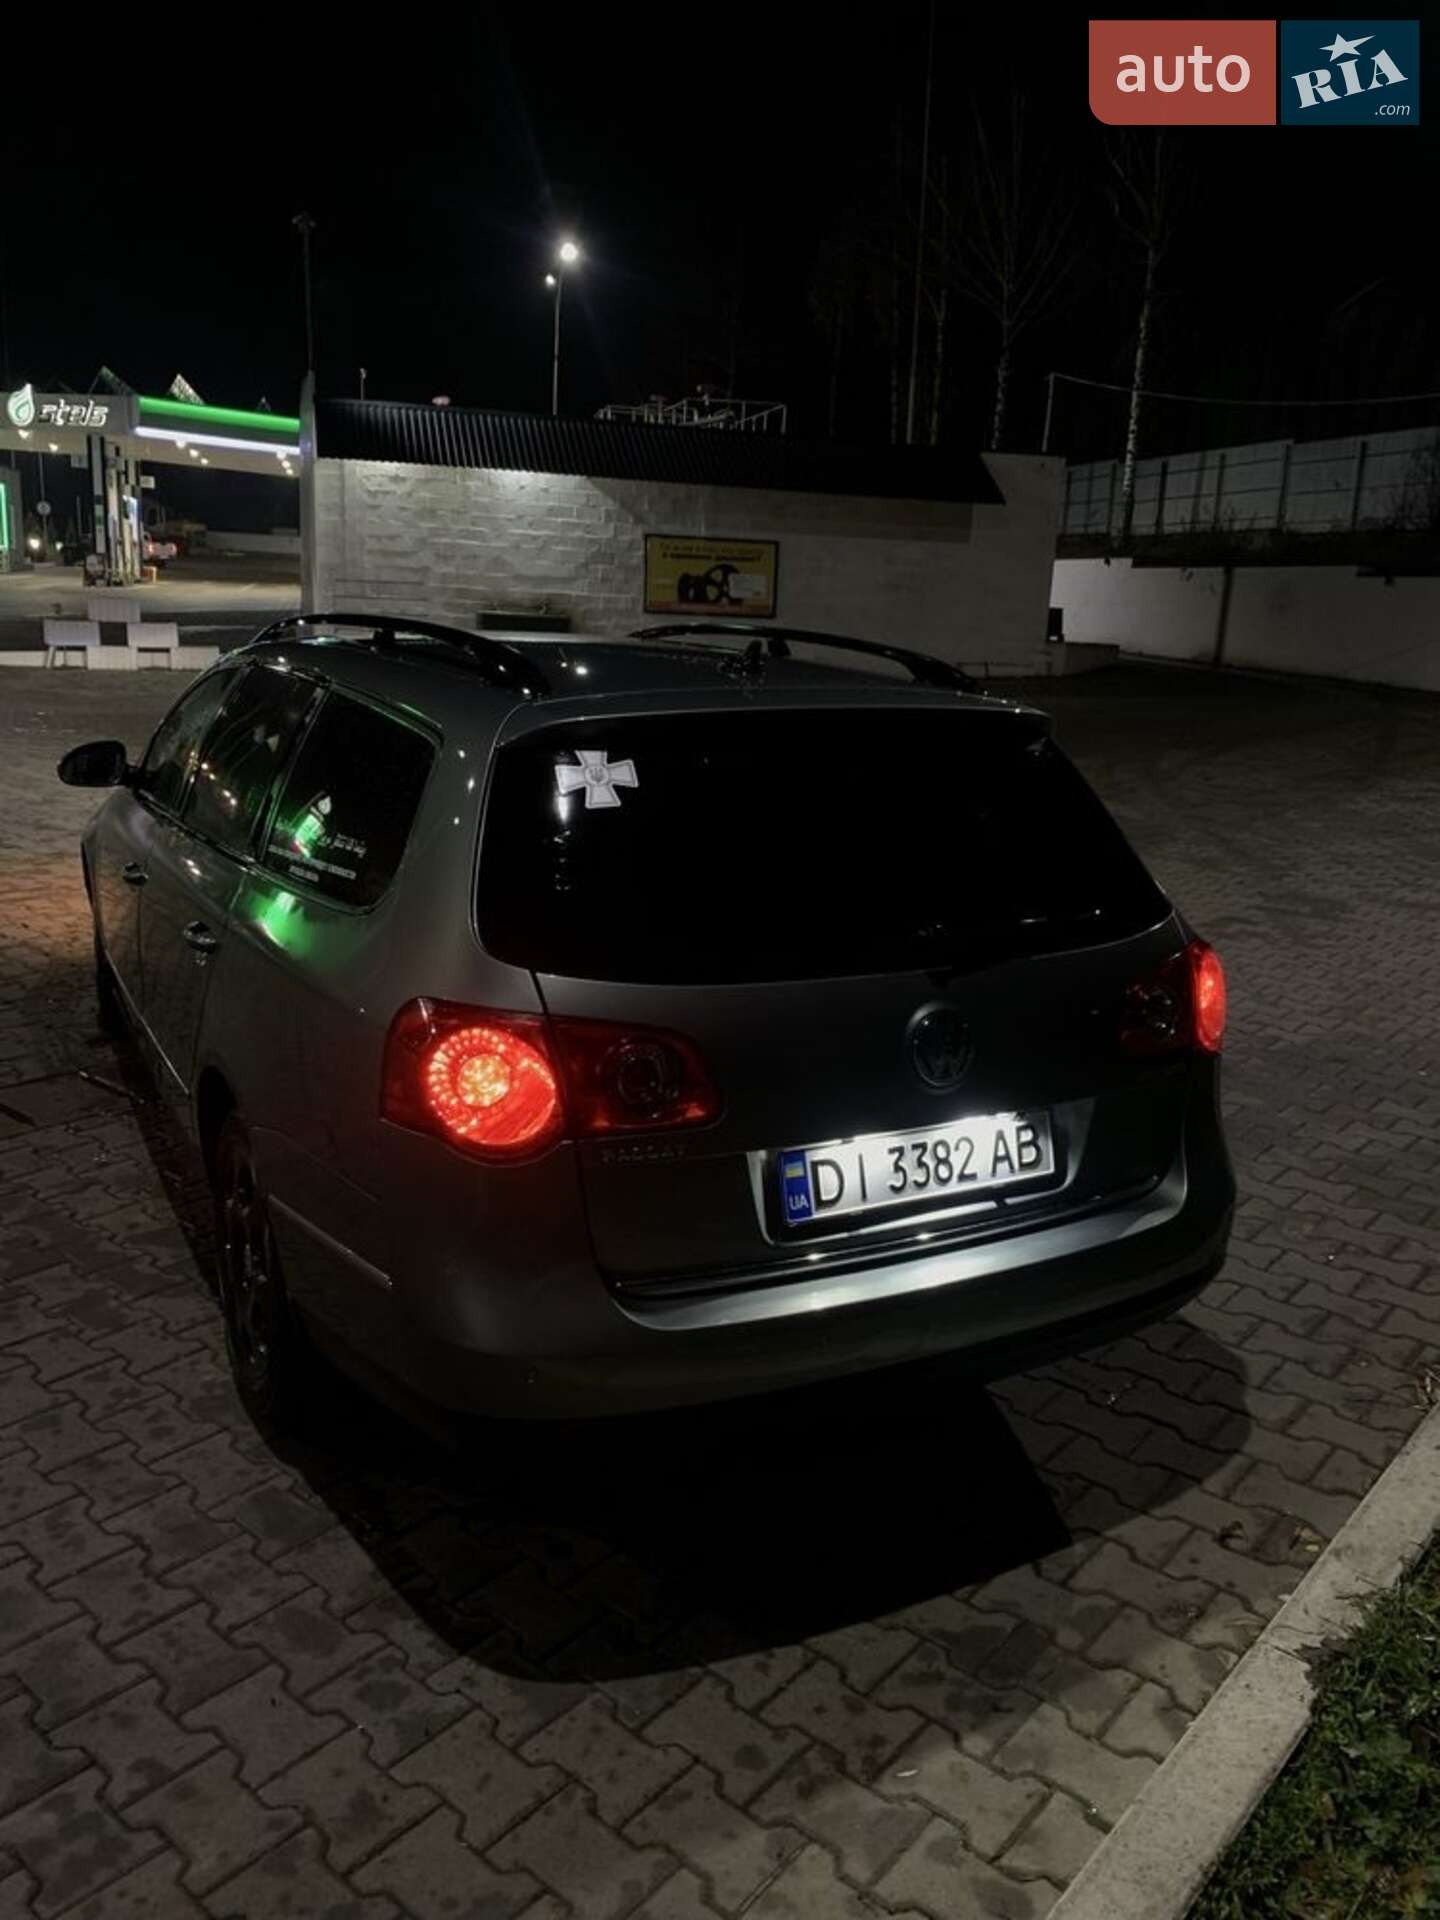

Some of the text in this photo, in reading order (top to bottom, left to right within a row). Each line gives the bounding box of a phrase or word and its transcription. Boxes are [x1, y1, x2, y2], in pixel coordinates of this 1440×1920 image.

[809, 1123, 1044, 1212] DI 3382 AB
[788, 1194, 810, 1211] UA
